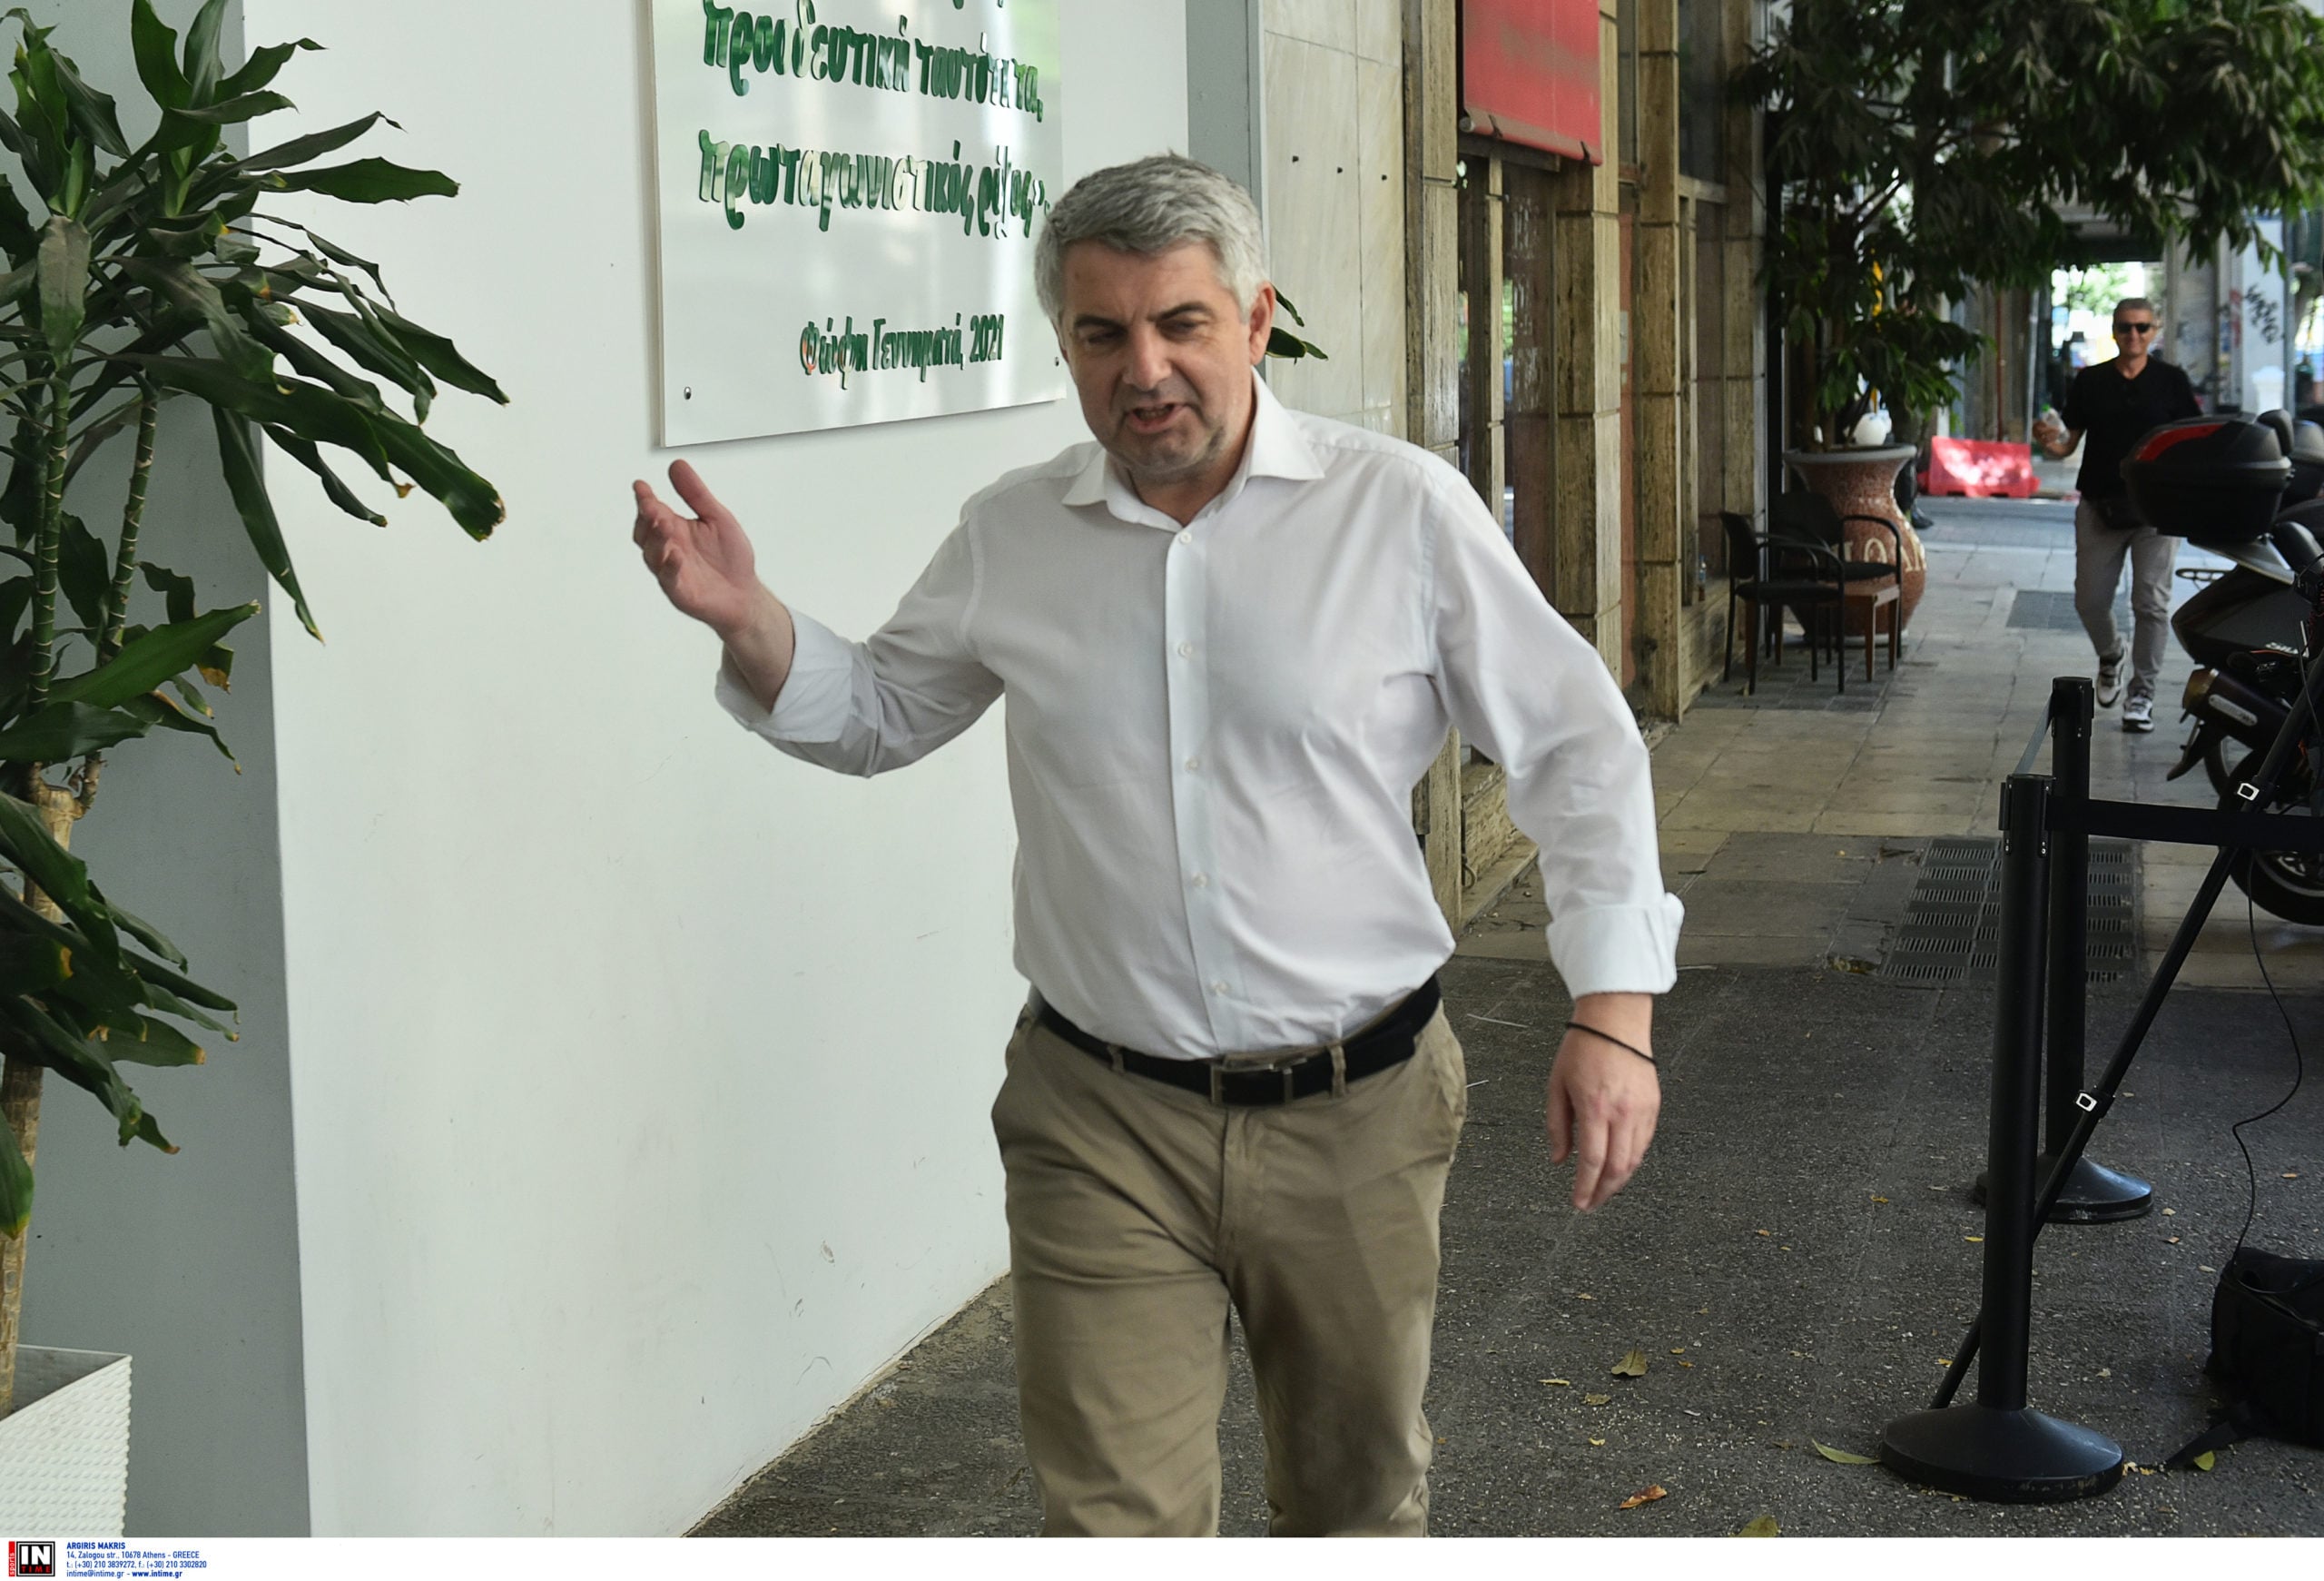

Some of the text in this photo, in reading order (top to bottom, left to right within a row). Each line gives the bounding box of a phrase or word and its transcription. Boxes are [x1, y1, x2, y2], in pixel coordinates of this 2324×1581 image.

[699, 130, 974, 236] πρωταγωνιστικός
[800, 312, 1004, 390] Φώφη Γεννηματά, 2021
